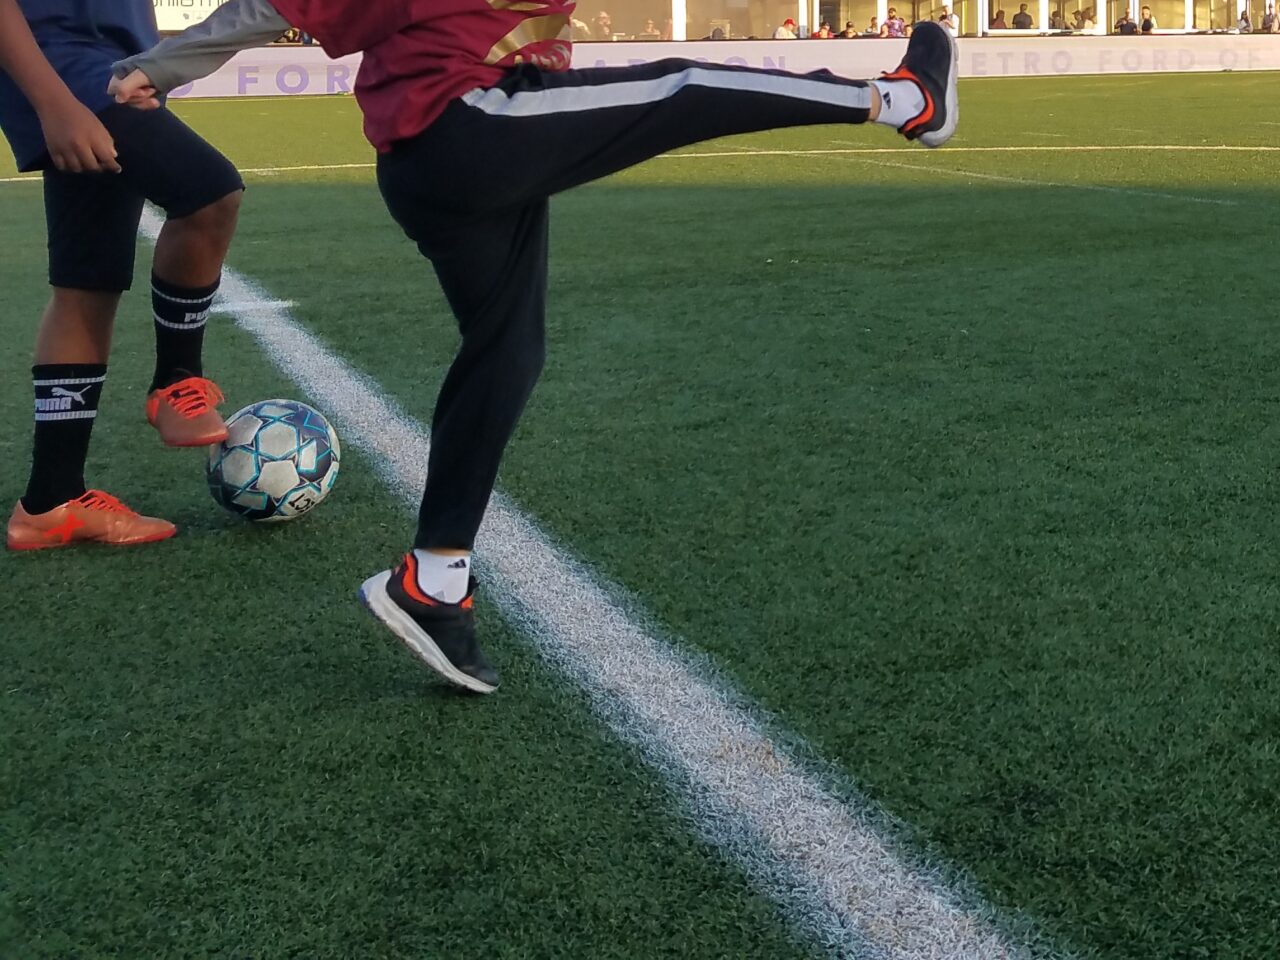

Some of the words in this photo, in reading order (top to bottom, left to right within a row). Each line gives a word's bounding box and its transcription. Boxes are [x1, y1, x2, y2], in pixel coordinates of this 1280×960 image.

[971, 49, 1073, 76] ETRO
[1098, 48, 1196, 73] FORD
[1219, 47, 1261, 70] OF
[237, 63, 351, 95] FOR
